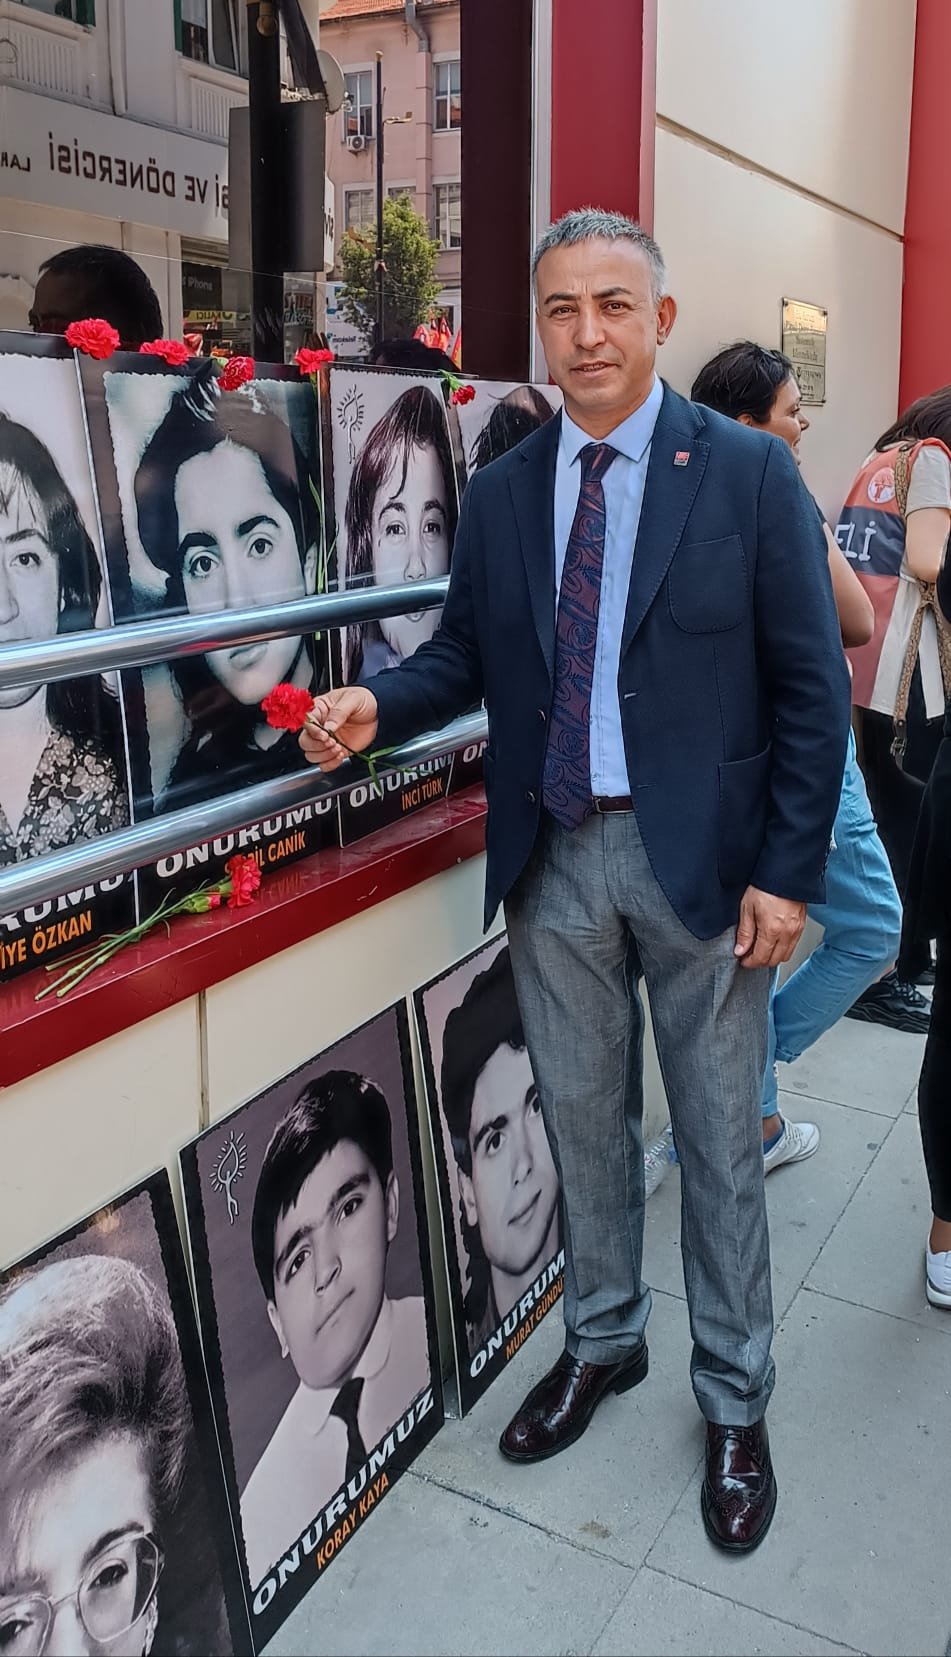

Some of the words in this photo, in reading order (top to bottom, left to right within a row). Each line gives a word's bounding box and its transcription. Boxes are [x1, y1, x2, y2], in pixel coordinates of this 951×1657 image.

[401, 784, 421, 811] İNCİ
[422, 777, 443, 801] TÜRK
[156, 797, 337, 878] ONURUMU
[268, 830, 306, 862] CANİK
[32, 910, 92, 954] ÖZKAN
[505, 1317, 535, 1360] MURAT
[252, 1388, 434, 1616] ONURUMUZ
[317, 1508, 357, 1570] KORAY
[359, 1472, 389, 1518] KAYA
